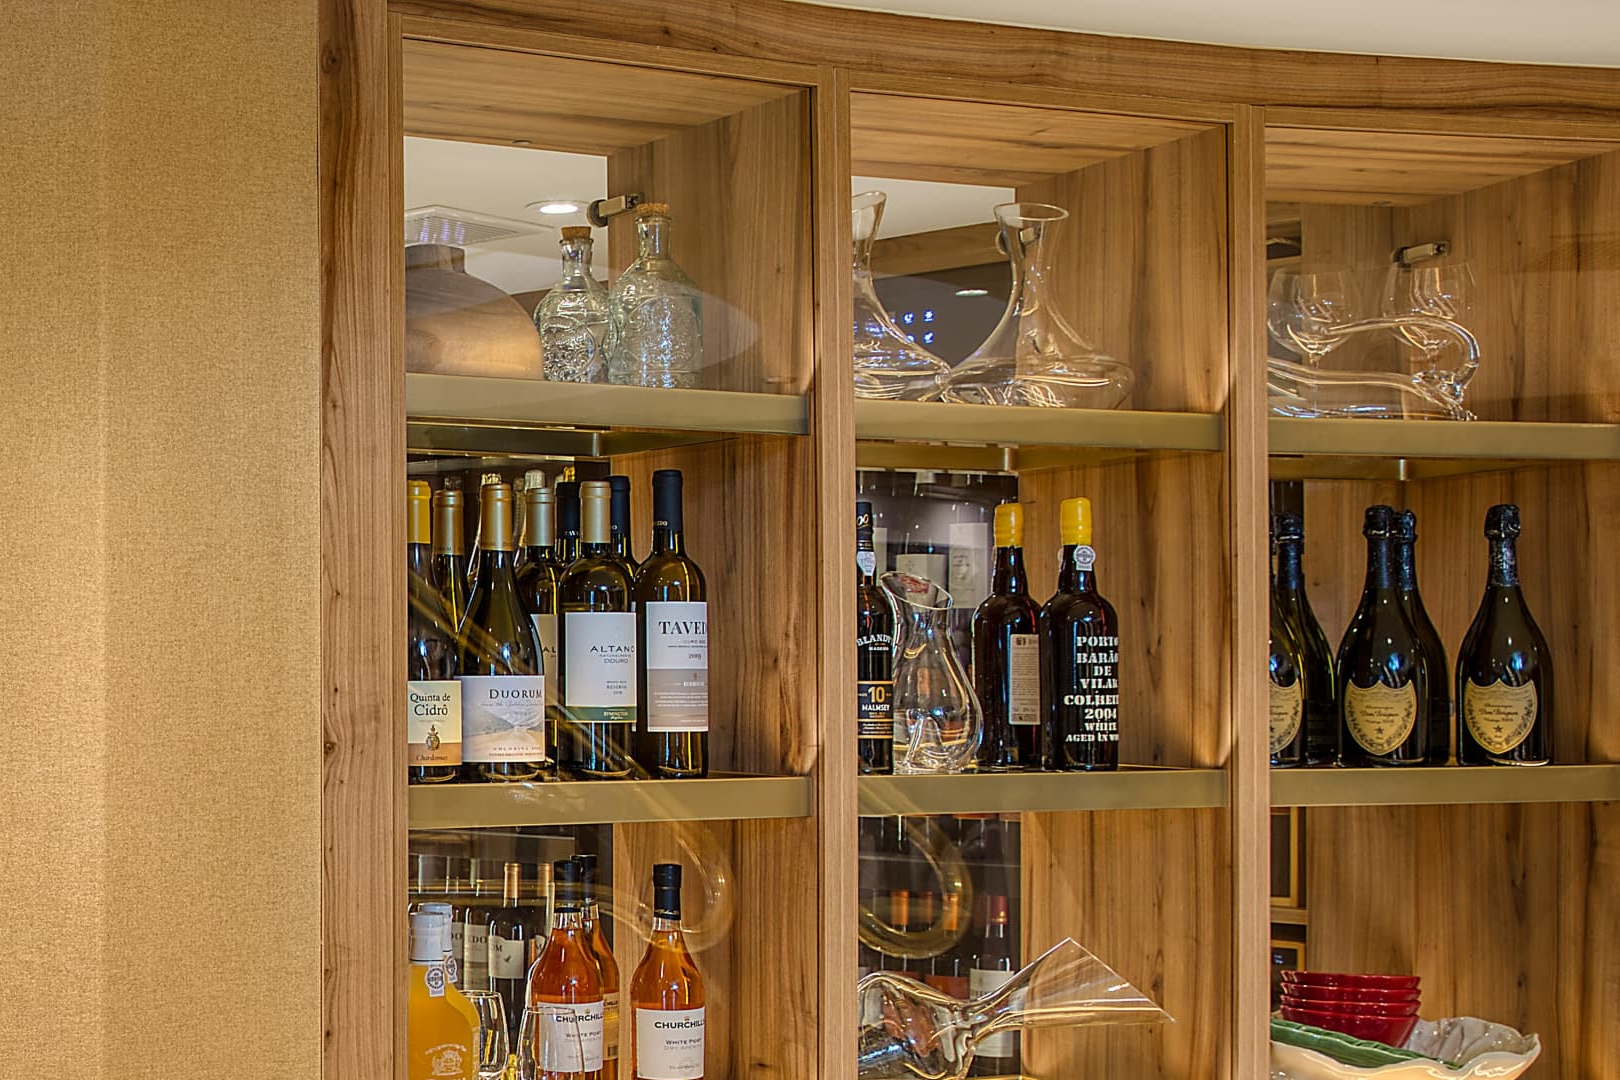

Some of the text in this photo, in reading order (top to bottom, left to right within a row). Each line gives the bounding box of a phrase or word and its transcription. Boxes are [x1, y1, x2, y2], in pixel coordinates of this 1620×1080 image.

[1094, 666, 1112, 676] DE
[410, 692, 451, 703] Quinta de
[489, 688, 542, 699] DUORUM
[867, 686, 885, 703] 10
[414, 704, 448, 716] Cidrô
[1065, 734, 1095, 742] AGED
